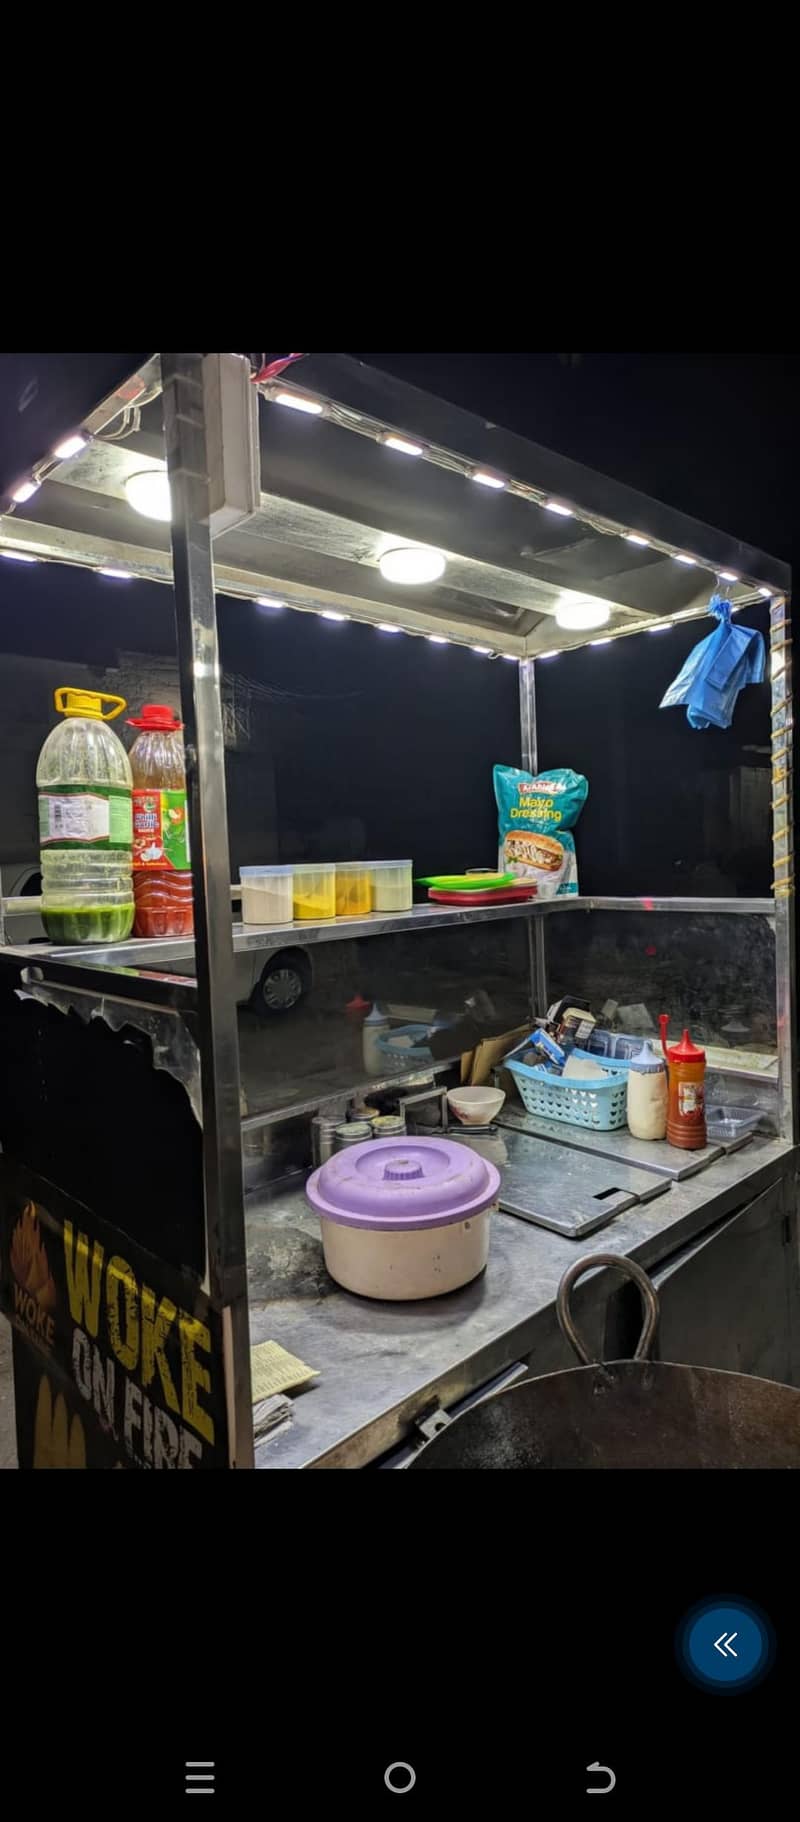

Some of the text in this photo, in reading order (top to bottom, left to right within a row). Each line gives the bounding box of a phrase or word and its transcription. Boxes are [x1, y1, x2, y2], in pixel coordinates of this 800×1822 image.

[519, 797, 553, 810] Mayo
[14, 1283, 56, 1342] WOKE
[63, 1218, 215, 1446] WOKE
[72, 1328, 116, 1438] ON
